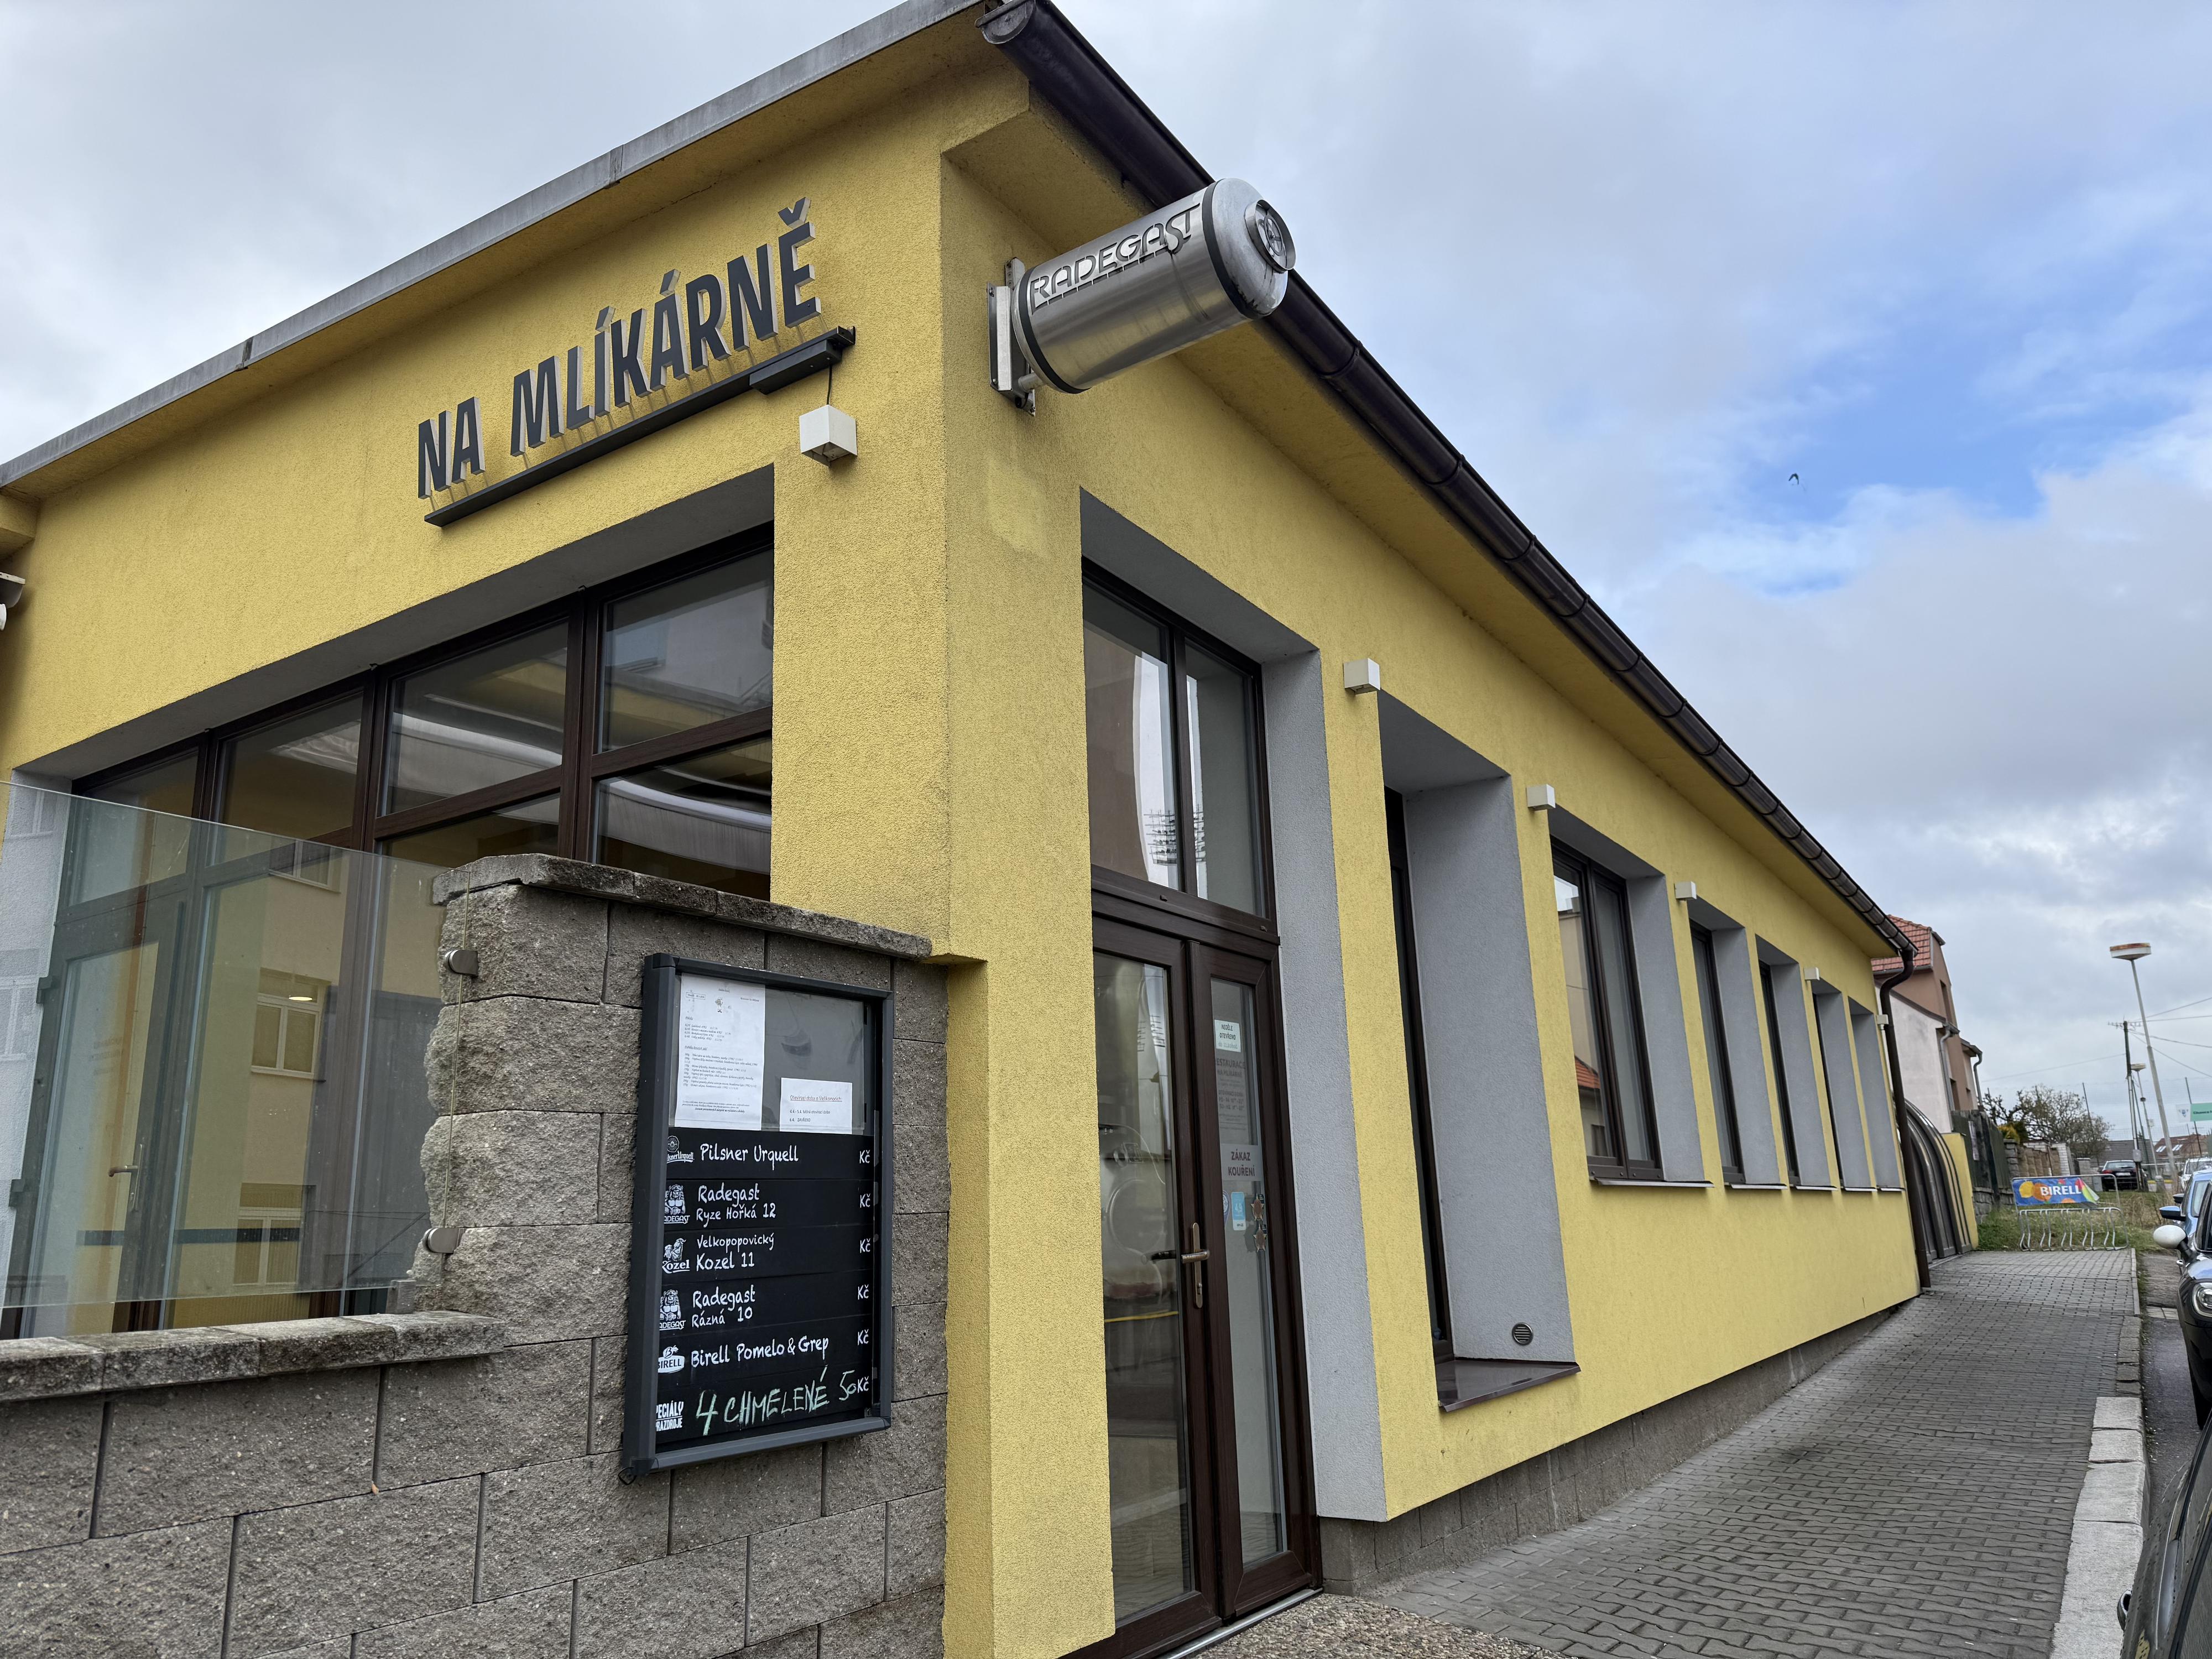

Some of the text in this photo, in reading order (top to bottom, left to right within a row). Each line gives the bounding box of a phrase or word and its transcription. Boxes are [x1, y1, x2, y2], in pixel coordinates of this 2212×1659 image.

[1030, 202, 1201, 315] RADEGAST
[418, 197, 821, 499] NA MLÍKÁRNĚ
[1216, 1058, 1246, 1069] ESTAURACE
[700, 1142, 870, 1171] Pilsner Urquell Kč
[1231, 1149, 1251, 1161] ZÁKAZ
[1228, 1164, 1255, 1176] KOUŘENÍ
[698, 1182, 871, 1208] Radegast Kč
[2040, 1185, 2082, 1196] BIRELL
[664, 1215, 690, 1224] ADEGAST
[696, 1202, 776, 1228] Ryze Hořká 12
[697, 1232, 871, 1253] Velkopopovický Kč
[696, 1251, 755, 1271] Kozel 11
[692, 1284, 869, 1311] Radegast Kč
[659, 1320, 686, 1330] ADEGAST
[691, 1306, 753, 1328] Rázná 10
[691, 1344, 731, 1368] Birell
[737, 1338, 785, 1361] Pomelo
[797, 1335, 829, 1360] Grep
[857, 1329, 869, 1345] Kč
[656, 1400, 684, 1419] ECIÁLY
[696, 1364, 869, 1436] 4 CHMELENÉ 50 Kč
[656, 1417, 683, 1432] RAZDROJE
